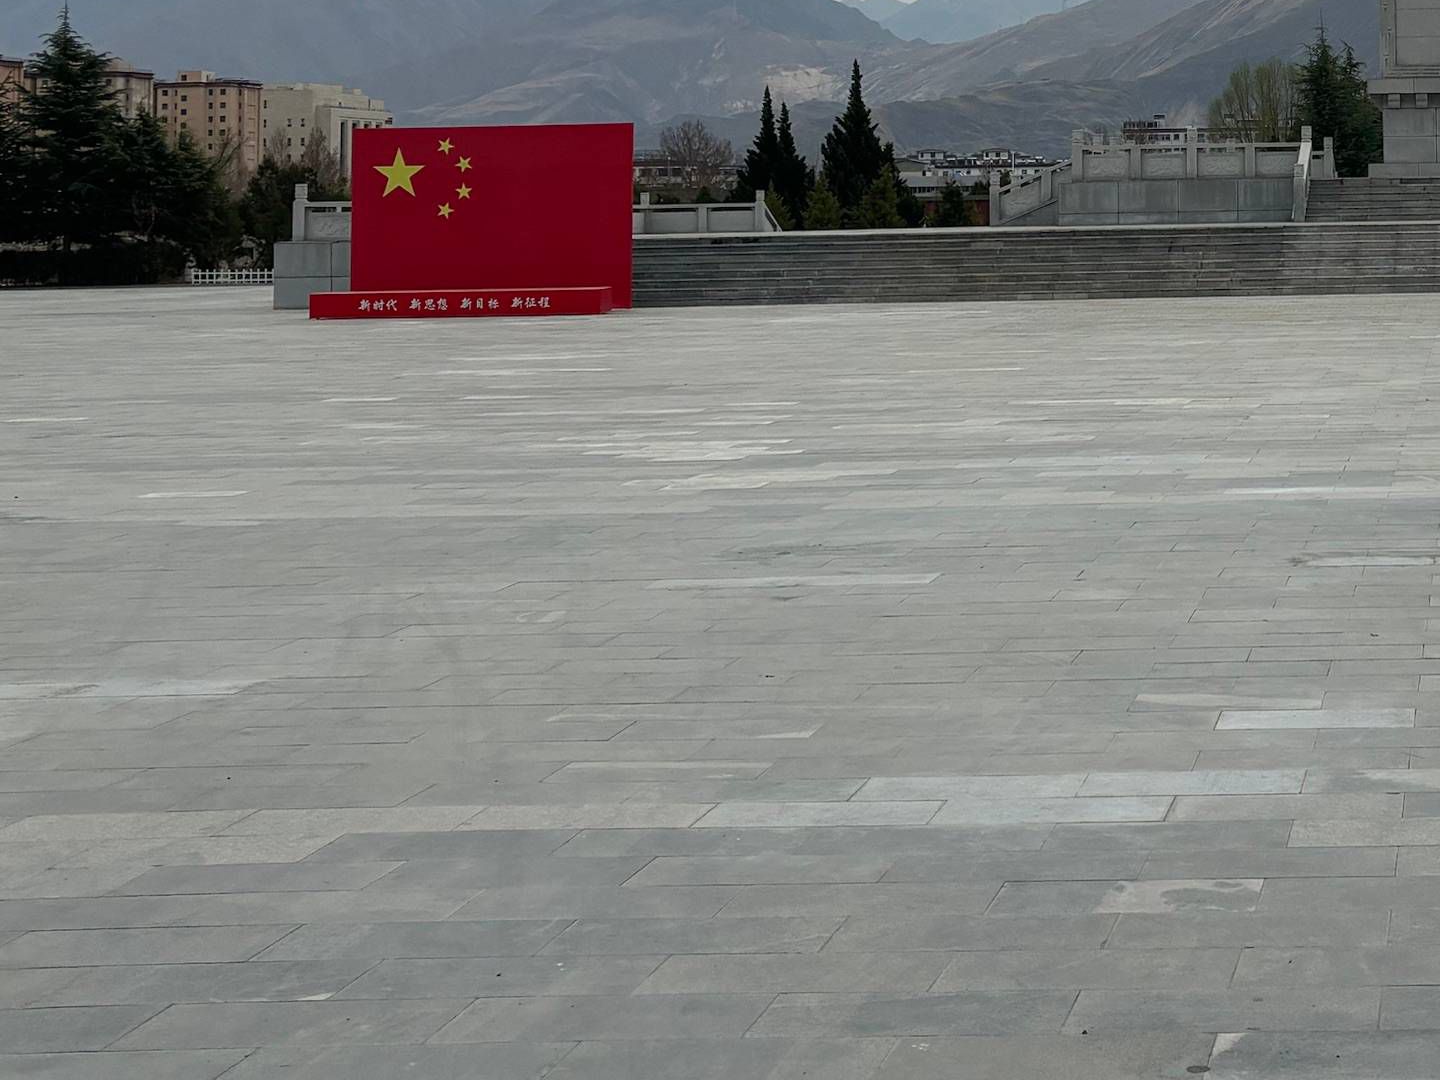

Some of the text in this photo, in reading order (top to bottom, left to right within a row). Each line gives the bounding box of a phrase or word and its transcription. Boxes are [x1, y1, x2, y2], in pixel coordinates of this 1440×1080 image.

[358, 296, 551, 312] 新时代 新思想 新目标 新征程
